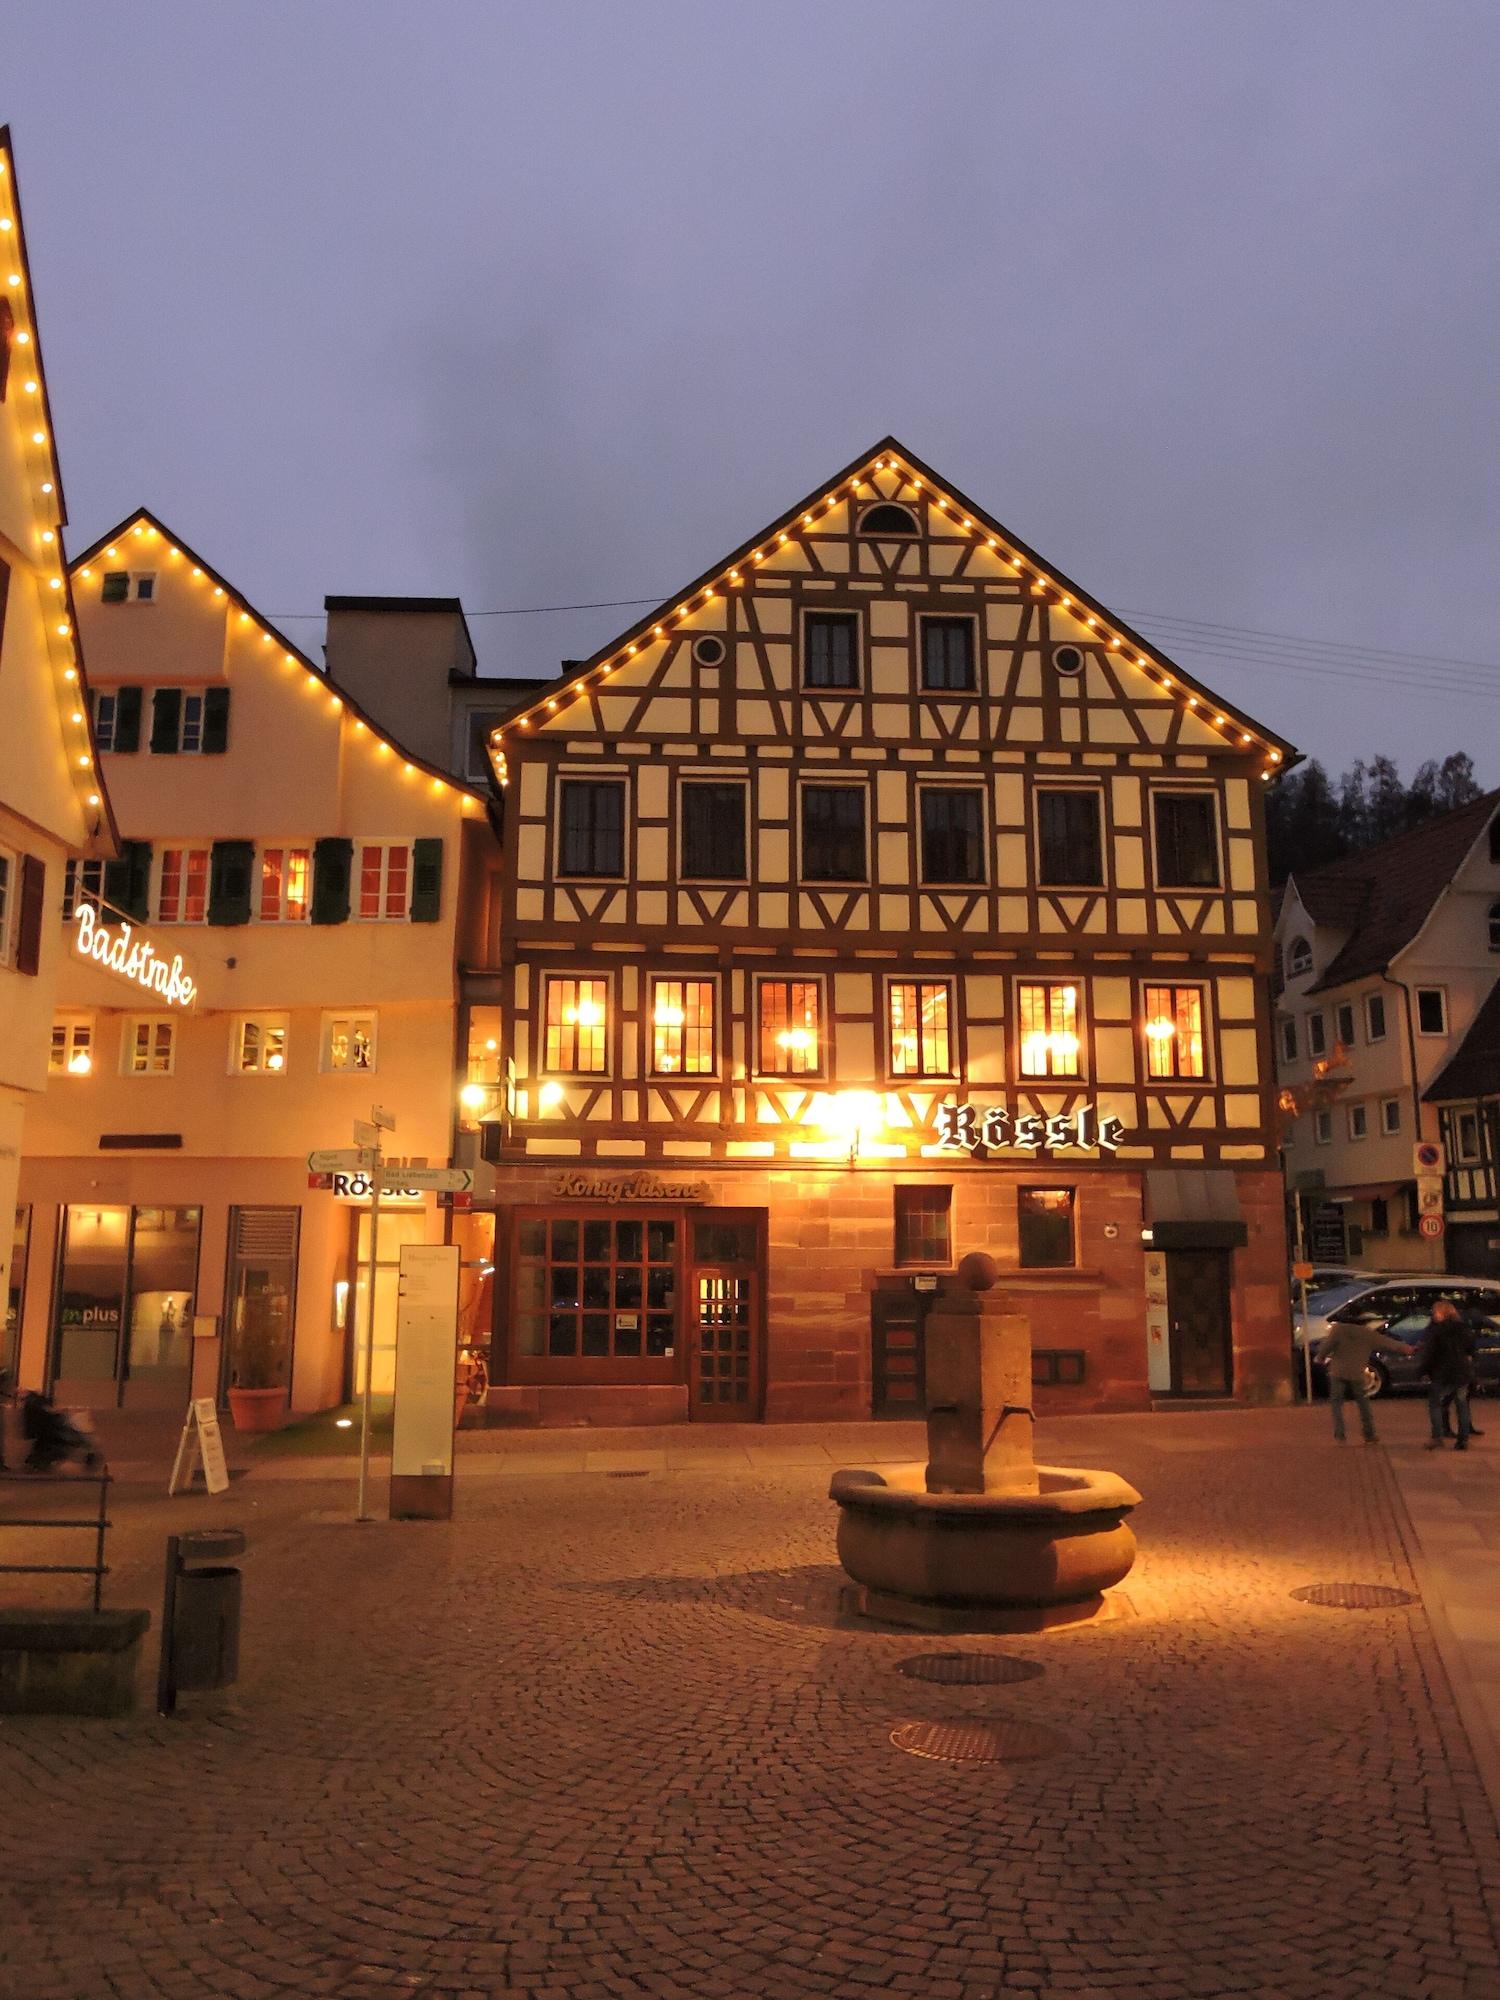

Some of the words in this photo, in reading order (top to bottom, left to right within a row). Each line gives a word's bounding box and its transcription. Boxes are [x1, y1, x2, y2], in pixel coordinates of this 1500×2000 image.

[75, 903, 197, 1005] Badstraße
[932, 1103, 1124, 1151] Rössle
[1426, 1221, 1438, 1232] 10
